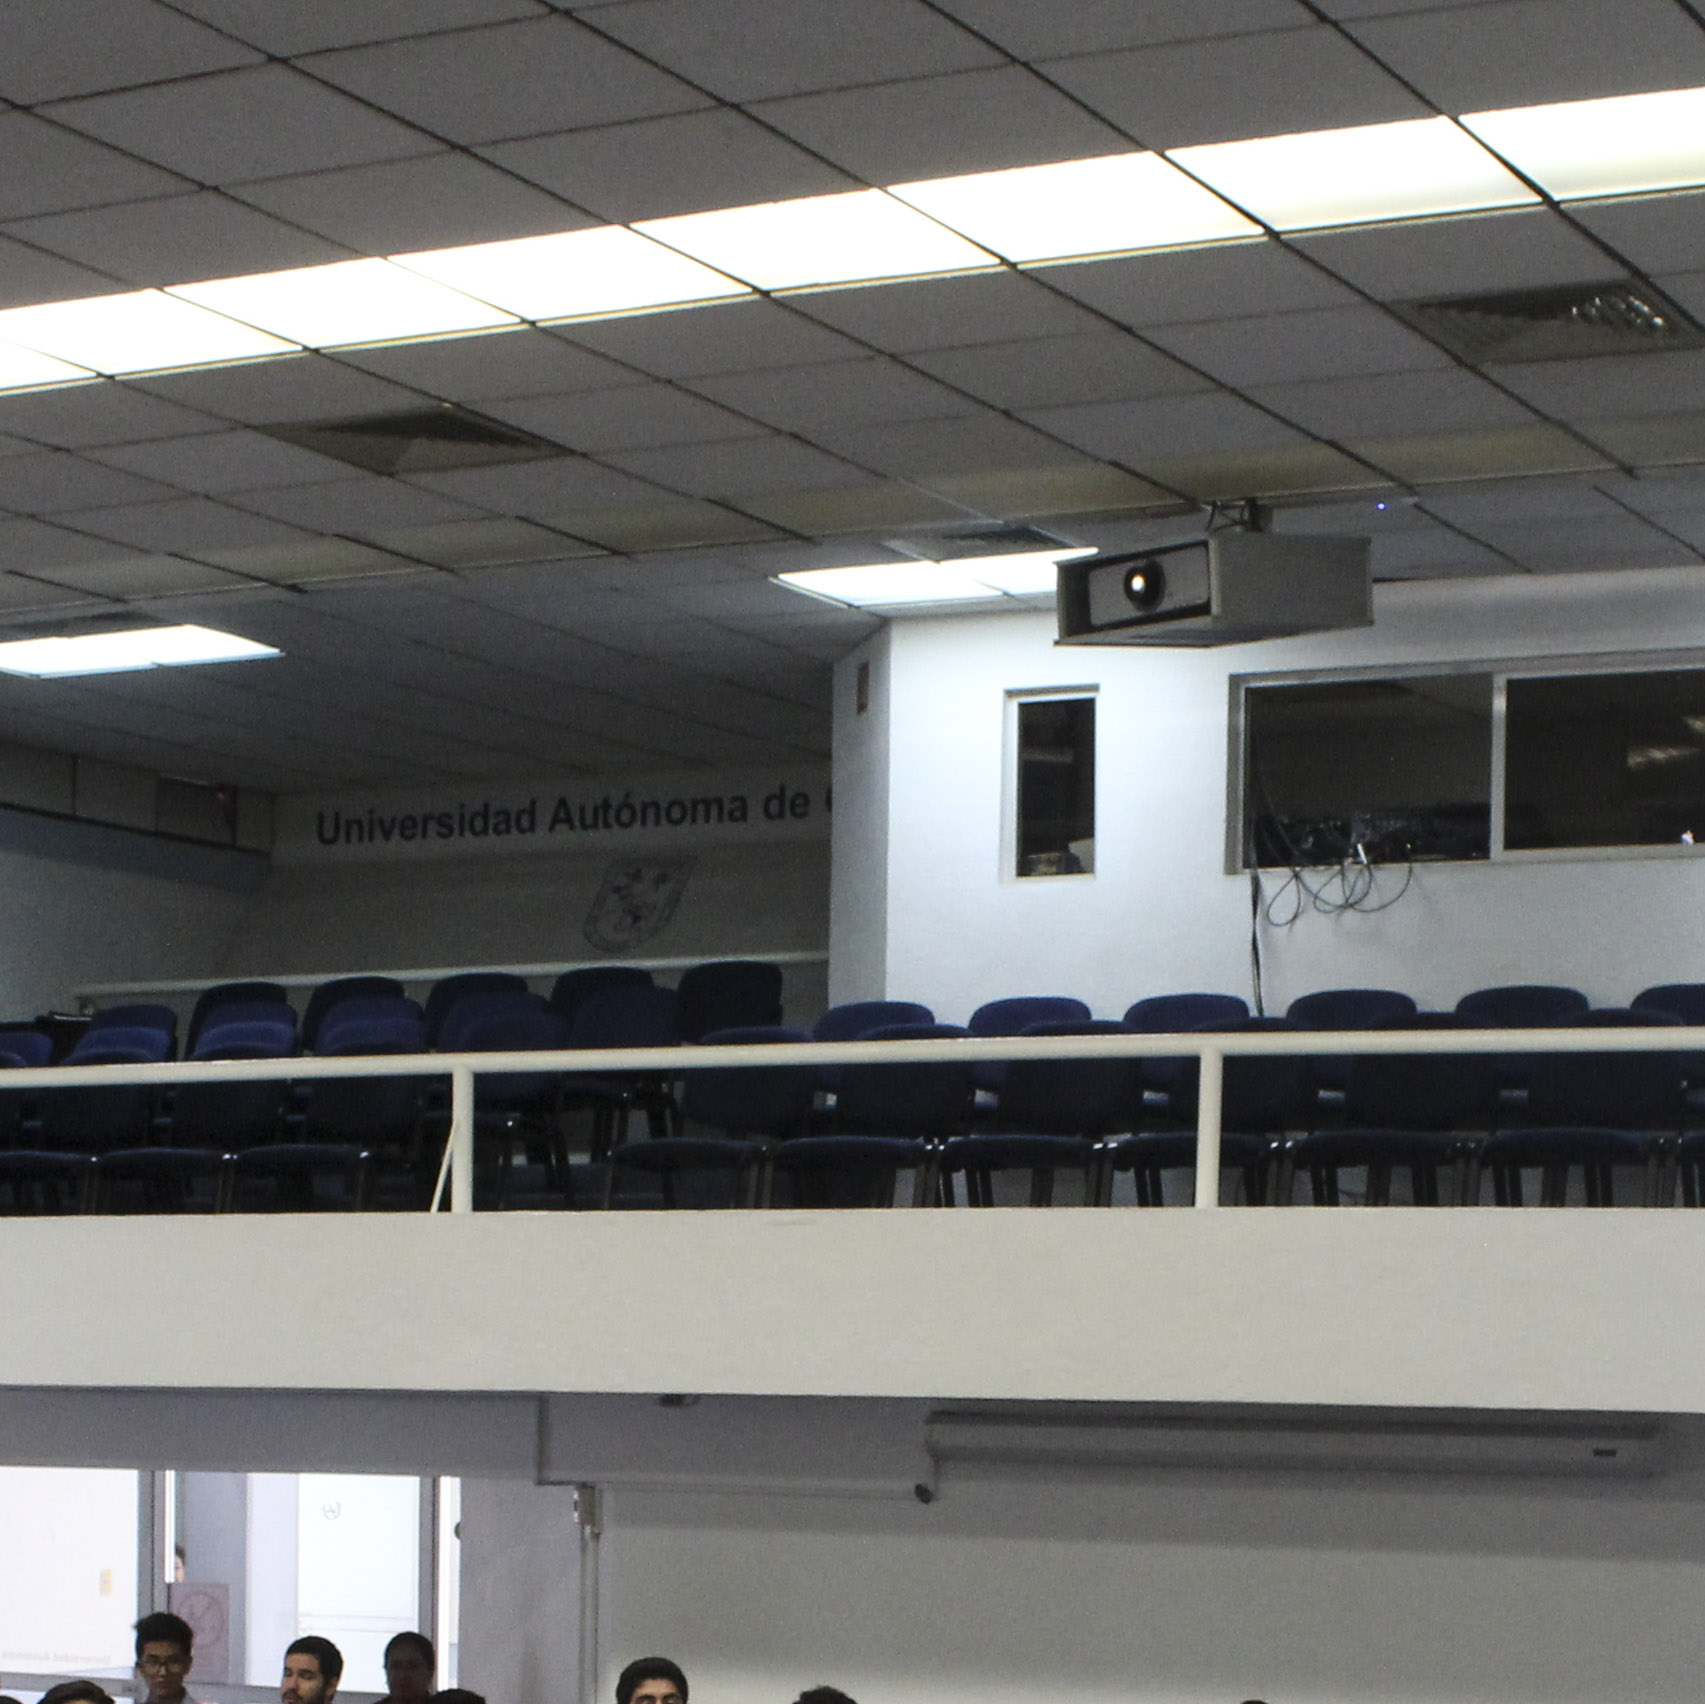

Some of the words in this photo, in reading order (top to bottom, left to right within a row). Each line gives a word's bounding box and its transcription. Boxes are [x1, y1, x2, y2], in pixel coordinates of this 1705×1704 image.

[316, 798, 537, 845] Universidad
[548, 791, 749, 832] Autónoma
[762, 784, 810, 820] de
